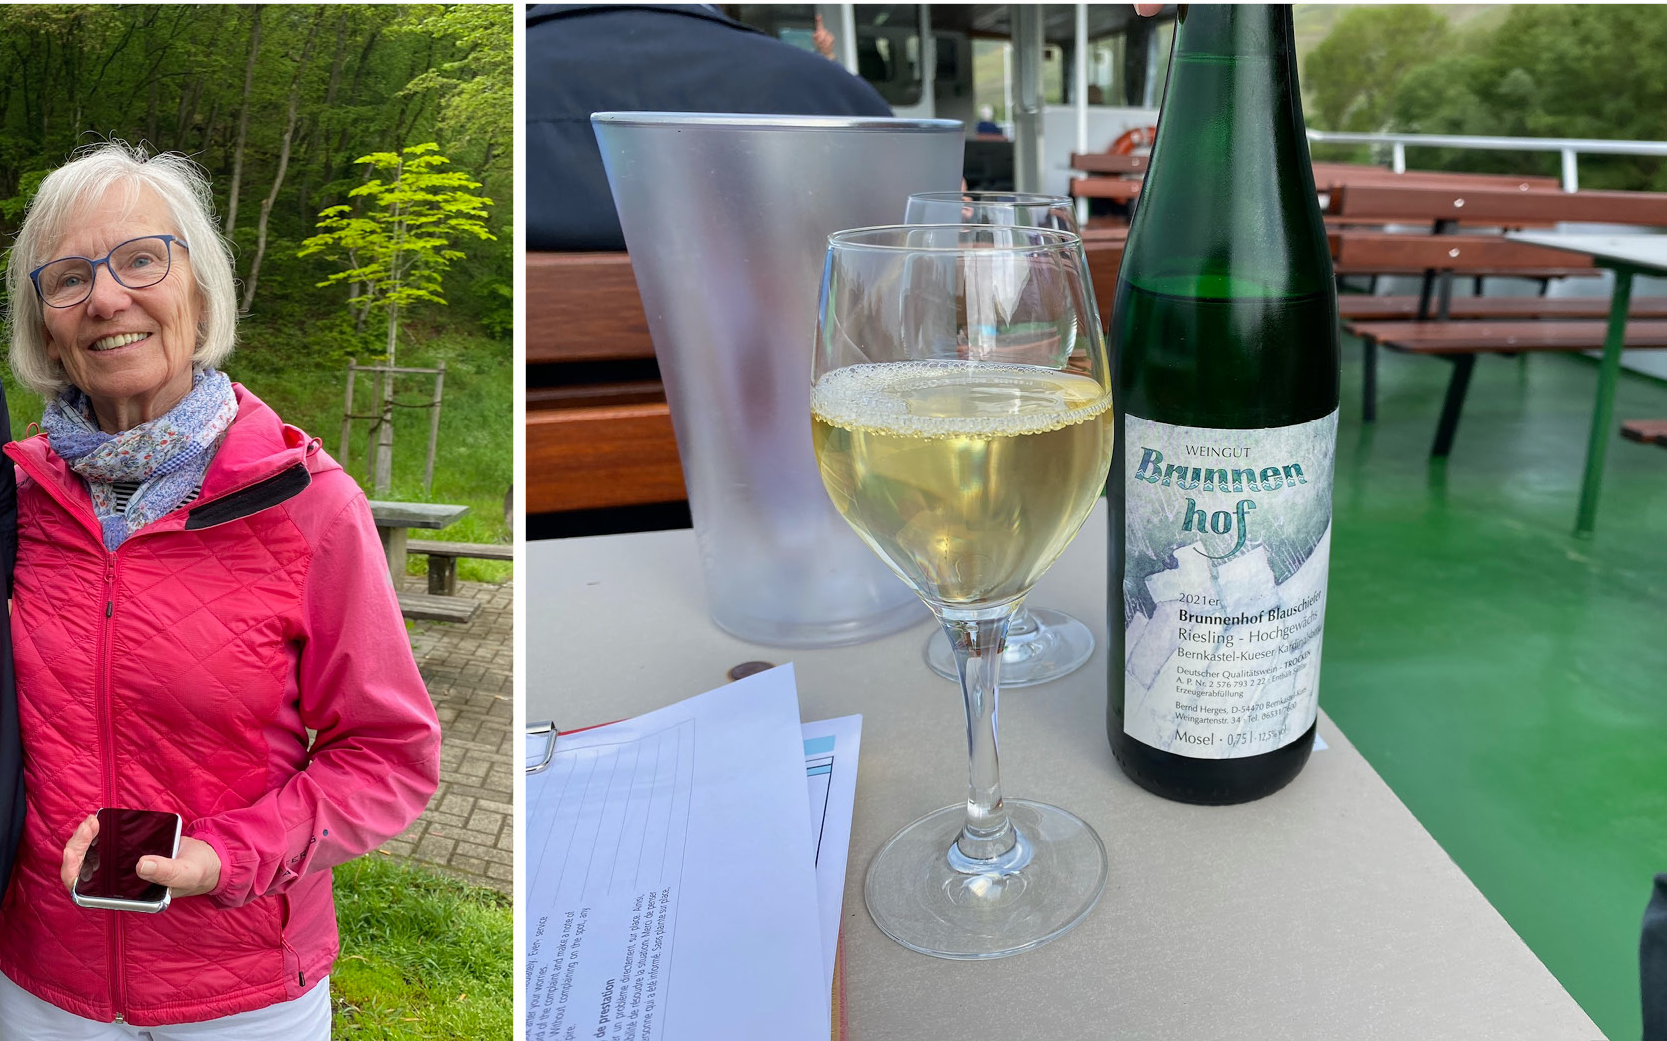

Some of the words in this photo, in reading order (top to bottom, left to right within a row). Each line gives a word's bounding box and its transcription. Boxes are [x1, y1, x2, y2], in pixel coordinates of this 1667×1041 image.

[1185, 444, 1251, 458] WEINGUT
[1134, 446, 1308, 492] Brunnen
[1181, 497, 1256, 560] hof
[1178, 593, 1220, 606] 2021er
[1179, 608, 1264, 626] Brunnenhof
[1268, 590, 1322, 622] Blauschiefer
[1178, 628, 1234, 648] Riesling
[1249, 610, 1318, 643] Hochgewächs
[1178, 647, 1276, 662] Bernkastel-Kueser
[1176, 666, 1220, 678] Deutscher
[1222, 666, 1278, 678] Qualitätswein
[1284, 650, 1312, 668] TROCKEN
[1176, 676, 1184, 684] A.
[1186, 678, 1192, 686] P.
[1234, 680, 1248, 688] 793
[1176, 686, 1244, 698] Erzeugerabfüllung
[1176, 702, 1198, 713] Bernd
[1200, 705, 1228, 716] Herges,
[1232, 704, 1264, 714] D-54470
[1175, 712, 1228, 725] Weingartenstr.
[1231, 716, 1241, 724] 34
[1247, 715, 1260, 723] Tel.
[1174, 729, 1214, 746] Mosel
[1227, 733, 1246, 747] 0,75
[570, 938, 582, 948] the
[570, 950, 578, 959] on
[559, 962, 578, 1004] complaining
[598, 978, 616, 1024] prestation
[549, 1006, 566, 1038] Without
[614, 1022, 622, 1032] un
[593, 1026, 606, 1038] de
